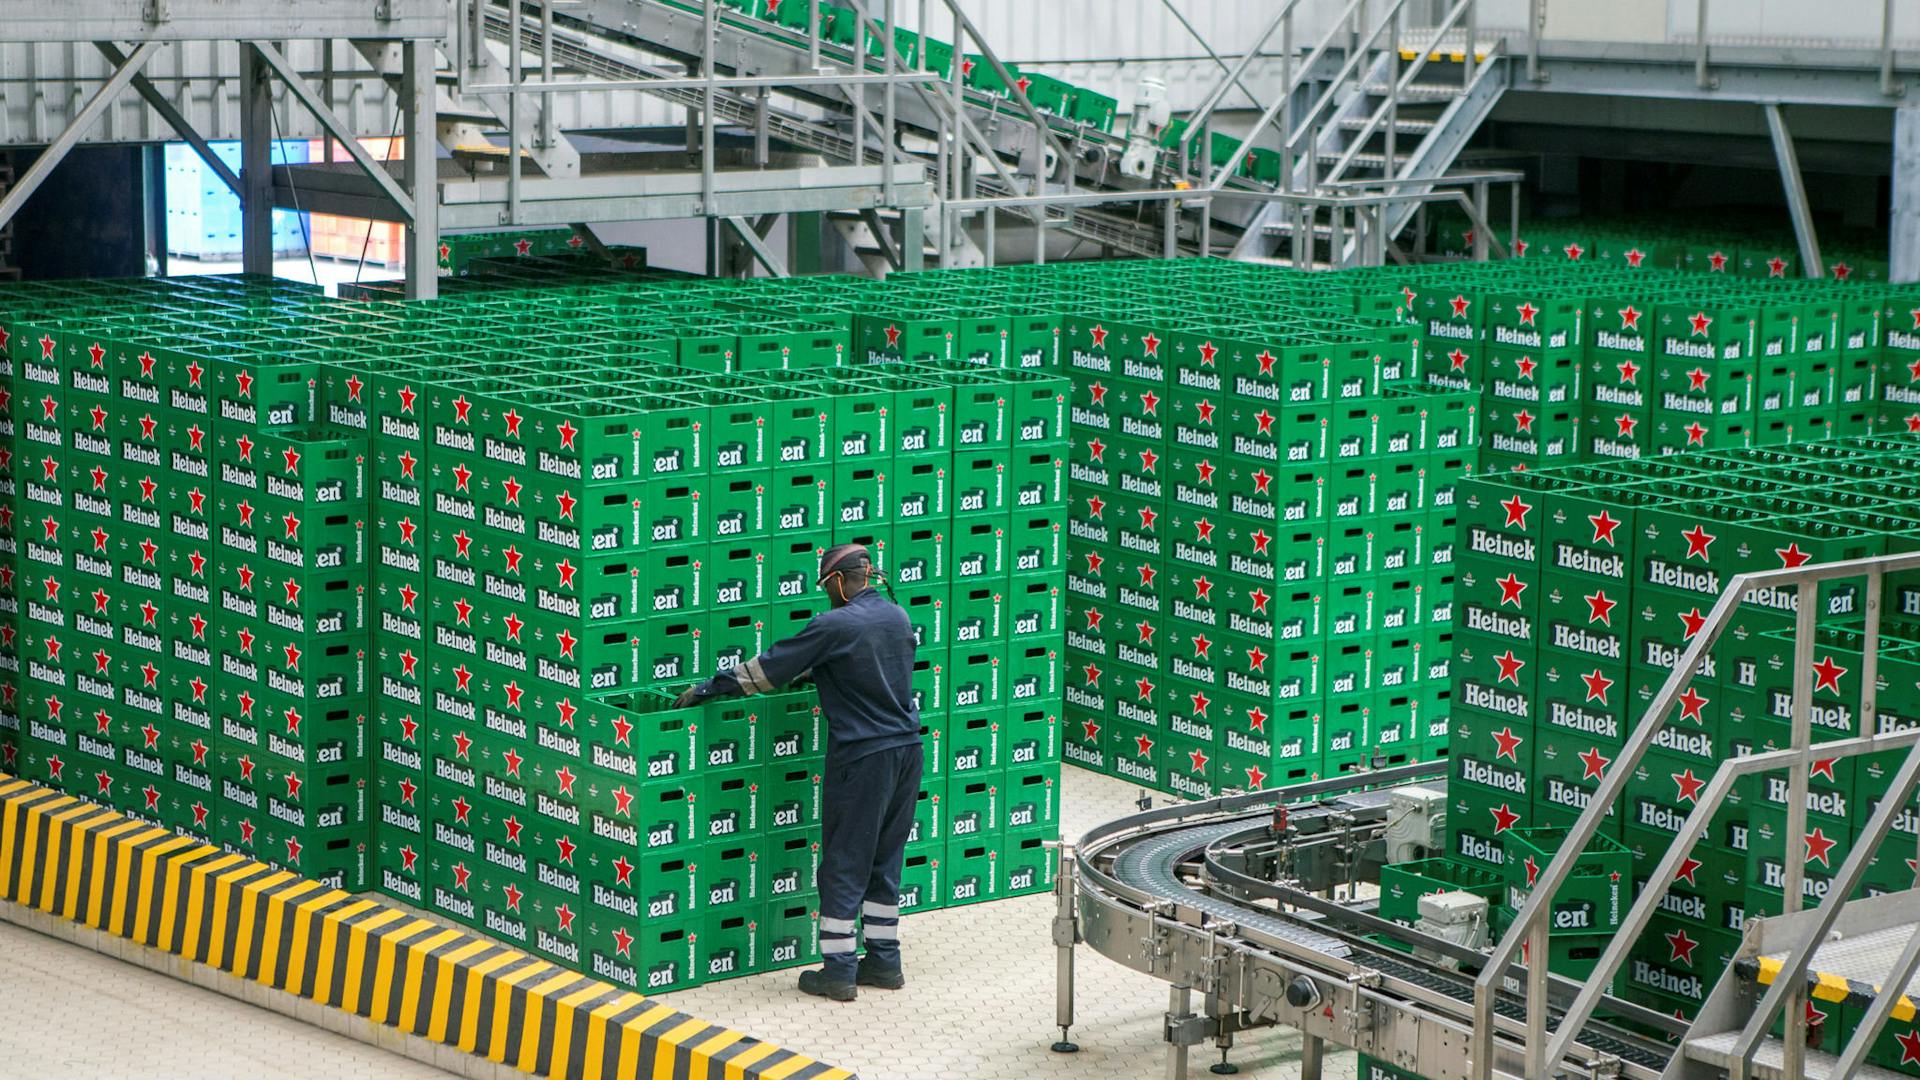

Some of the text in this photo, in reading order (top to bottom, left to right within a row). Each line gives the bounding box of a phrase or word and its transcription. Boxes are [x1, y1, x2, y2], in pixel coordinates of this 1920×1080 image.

[25, 363, 60, 384] Heinek
[1073, 351, 1110, 371] Heinek
[1125, 360, 1163, 380] Heinek
[73, 371, 109, 393] Heinek
[123, 380, 159, 403] Heinek
[1180, 369, 1220, 389] Heinek
[1237, 378, 1279, 400] Heinek
[172, 390, 207, 413] Heinek
[221, 400, 256, 423] Heinek
[330, 406, 366, 428] Heinek
[382, 416, 420, 440] Heinek
[1072, 408, 1109, 427] Heinek
[1123, 417, 1162, 438] Heinek
[27, 423, 61, 445] Heinek
[75, 432, 111, 455] Heinek
[436, 426, 475, 450] Heinek
[1178, 427, 1218, 447] Heinek
[124, 442, 160, 465] Heinek
[486, 439, 526, 465] Heinek
[1235, 437, 1277, 458] Heinek
[172, 453, 208, 476] Heinek
[222, 464, 257, 488] Heinek
[539, 452, 581, 478] Heinek
[1071, 464, 1108, 484] Heinek
[268, 476, 304, 500] Heinek
[1122, 475, 1161, 496] Heinek
[1177, 485, 1218, 507] Heinek
[75, 493, 111, 516] Heinek
[123, 504, 160, 527] Heinek
[436, 494, 475, 519] Heinek
[1233, 496, 1275, 518] Heinek
[173, 516, 209, 540] Heinek
[223, 527, 257, 552] Heinek
[538, 522, 580, 548] Heinek
[28, 543, 63, 565] Heinek
[268, 541, 304, 566] Heinek
[1121, 532, 1160, 553] Heinek
[1176, 543, 1217, 566] Heinek
[1472, 530, 1535, 560] Heinek
[382, 546, 419, 571] Heinek
[1231, 556, 1274, 578] Heinek
[1558, 545, 1624, 577] Heinek
[124, 566, 161, 589] Heinek
[486, 575, 525, 601] Heinek
[1650, 561, 1719, 594] Heinek
[174, 578, 209, 603] Heinek
[538, 589, 580, 617] Heinek
[1120, 588, 1159, 610] Heinek
[29, 602, 64, 626] Heinek
[268, 605, 304, 632] Heinek
[1175, 601, 1215, 624] Heinek
[1468, 607, 1531, 638] Heinek
[76, 615, 113, 638] Heinek
[383, 612, 421, 639] Heinek
[1230, 614, 1272, 637] Heinek
[437, 627, 476, 653] Heinek
[1554, 625, 1620, 657] Heinek
[174, 641, 210, 665] Heinek
[486, 642, 526, 670] Heinek
[1119, 645, 1158, 668] Heinek
[30, 662, 65, 685] Heinek
[223, 654, 257, 680] Heinek
[538, 659, 580, 688] Heinek
[1174, 659, 1214, 682] Heinek
[77, 675, 114, 698] Heinek
[268, 670, 304, 697] Heinek
[383, 677, 421, 704] Heinek
[1228, 672, 1270, 696] Heinek
[125, 688, 162, 713] Heinek
[436, 692, 475, 720] Heinek
[1118, 701, 1157, 724] Heinek
[1465, 684, 1528, 716] Heinek
[175, 703, 210, 728] Heinek
[1172, 716, 1213, 740] Heinek
[1552, 703, 1617, 737] Heinek
[223, 718, 258, 744] Heinek
[538, 727, 580, 756] Heinek
[1228, 731, 1270, 756] Heinek
[1651, 727, 1712, 758] einek
[79, 735, 115, 759] Heinek
[269, 734, 305, 762] Heinek
[383, 742, 421, 769] Heinek
[436, 759, 475, 786] Heinek
[593, 746, 637, 775] Heinek
[1117, 757, 1157, 781] Heinek
[176, 765, 212, 790] Heinek
[1463, 759, 1526, 793] Heinek
[224, 781, 257, 808] Heinek
[486, 777, 526, 805] Heinek
[269, 798, 305, 826] Heinek
[383, 805, 420, 832] Heinek
[538, 795, 580, 825] Heinek
[436, 824, 474, 852] Heinek
[593, 815, 637, 845] Heinek
[486, 843, 526, 872] Heinek
[384, 870, 421, 900] Heinek
[538, 863, 580, 894] Heinek
[435, 888, 474, 918] Heinek
[594, 885, 638, 915] Heinek
[1610, 884, 1618, 925] Heineken
[486, 910, 526, 940] Heinek
[537, 930, 579, 963] Heinek
[593, 954, 637, 986] Heinek
[1634, 960, 1702, 999] Heinek
